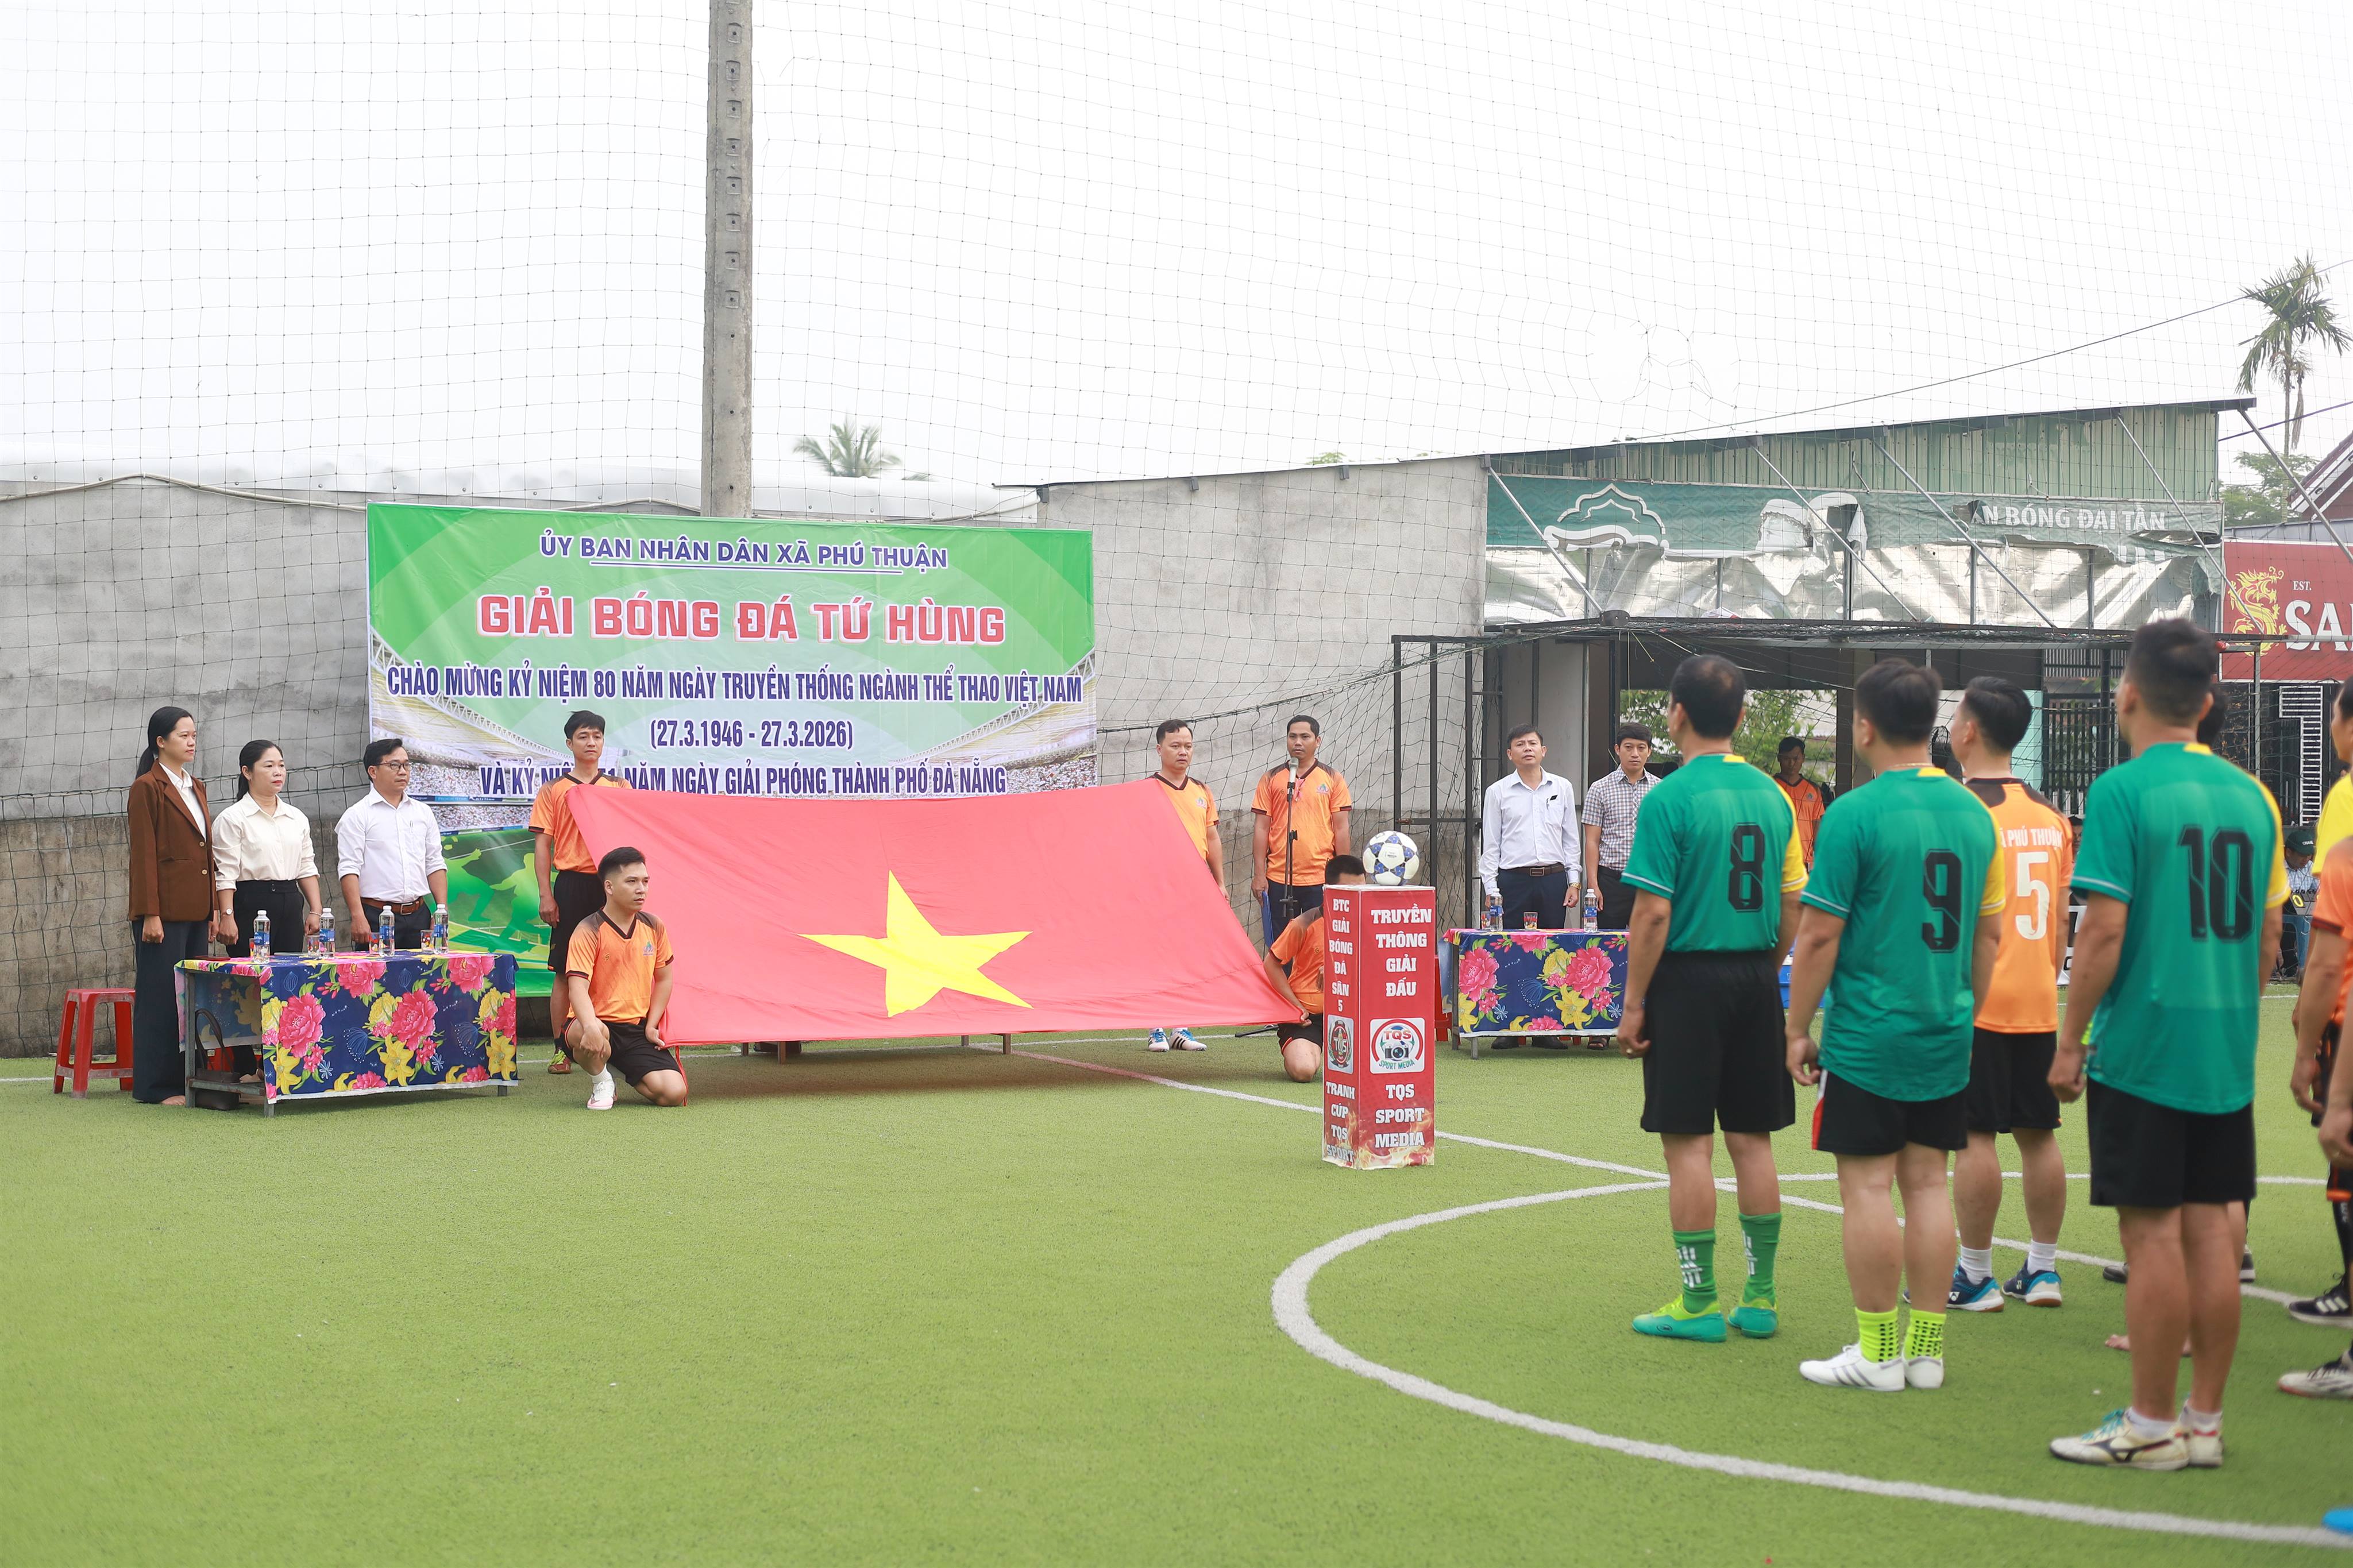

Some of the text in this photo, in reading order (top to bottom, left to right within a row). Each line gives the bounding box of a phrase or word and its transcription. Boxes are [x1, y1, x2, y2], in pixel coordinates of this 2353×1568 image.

[2005, 503, 2070, 528] BÓNG
[2077, 509, 2116, 535] ĐẠI
[2122, 504, 2166, 531] TÂN
[541, 529, 947, 573] ỦY BAN NHÂN DÂN XÃ PHÚ THUẬN
[2293, 581, 2312, 590] EST.
[480, 586, 1006, 643] GIẢI BÓNG ĐÁ TỨ HÙNG
[388, 661, 1082, 708] CHÀO MỪNG KỶ NIỆM 80 NĂM NGÀY TRUYỀN THỐNG NGÀNH THỂ THAO VIỆT NAM
[650, 719, 743, 750] (27.3.1946
[761, 720, 853, 750] 27.3.2026)
[480, 761, 506, 795] VÀ
[512, 758, 535, 795] KỶ
[624, 761, 666, 791] NĂM
[672, 762, 716, 793] NGÀY
[725, 758, 761, 794] GIẢI
[766, 760, 827, 793] PHÓNG
[832, 761, 890, 793] THÀNH
[895, 758, 928, 793] PHỐ
[933, 760, 955, 793] ĐÀ
[959, 758, 1006, 793] NẴNG
[2007, 825, 2028, 847] PHÚ
[1728, 821, 1765, 913] 8
[2178, 824, 2254, 943] 10
[1333, 898, 1349, 912] BTC
[1922, 848, 1962, 953] 9
[2015, 851, 2050, 940] 5
[1371, 903, 1432, 924] TRUYỀN
[1332, 917, 1350, 933] GIẢI
[1329, 938, 1353, 955] BÓNG
[1375, 930, 1427, 948] THÔNG
[1334, 960, 1347, 975] ĐÁ
[1386, 953, 1417, 972] GIẢI
[1332, 980, 1349, 997] SÂN
[1386, 977, 1417, 997] ĐẤU
[1337, 999, 1343, 1012] 5
[1384, 1029, 1412, 1041] TQS
[1379, 1059, 1415, 1069] SPORT MEDIA
[1326, 1080, 1355, 1100] TRANH
[1386, 1083, 1415, 1101] TQS
[1331, 1103, 1349, 1119] CÚP
[1375, 1107, 1425, 1124] SPORT
[1331, 1125, 1348, 1141] TQS
[1375, 1131, 1425, 1148] MEDIA
[1326, 1144, 1354, 1163] SPORT
